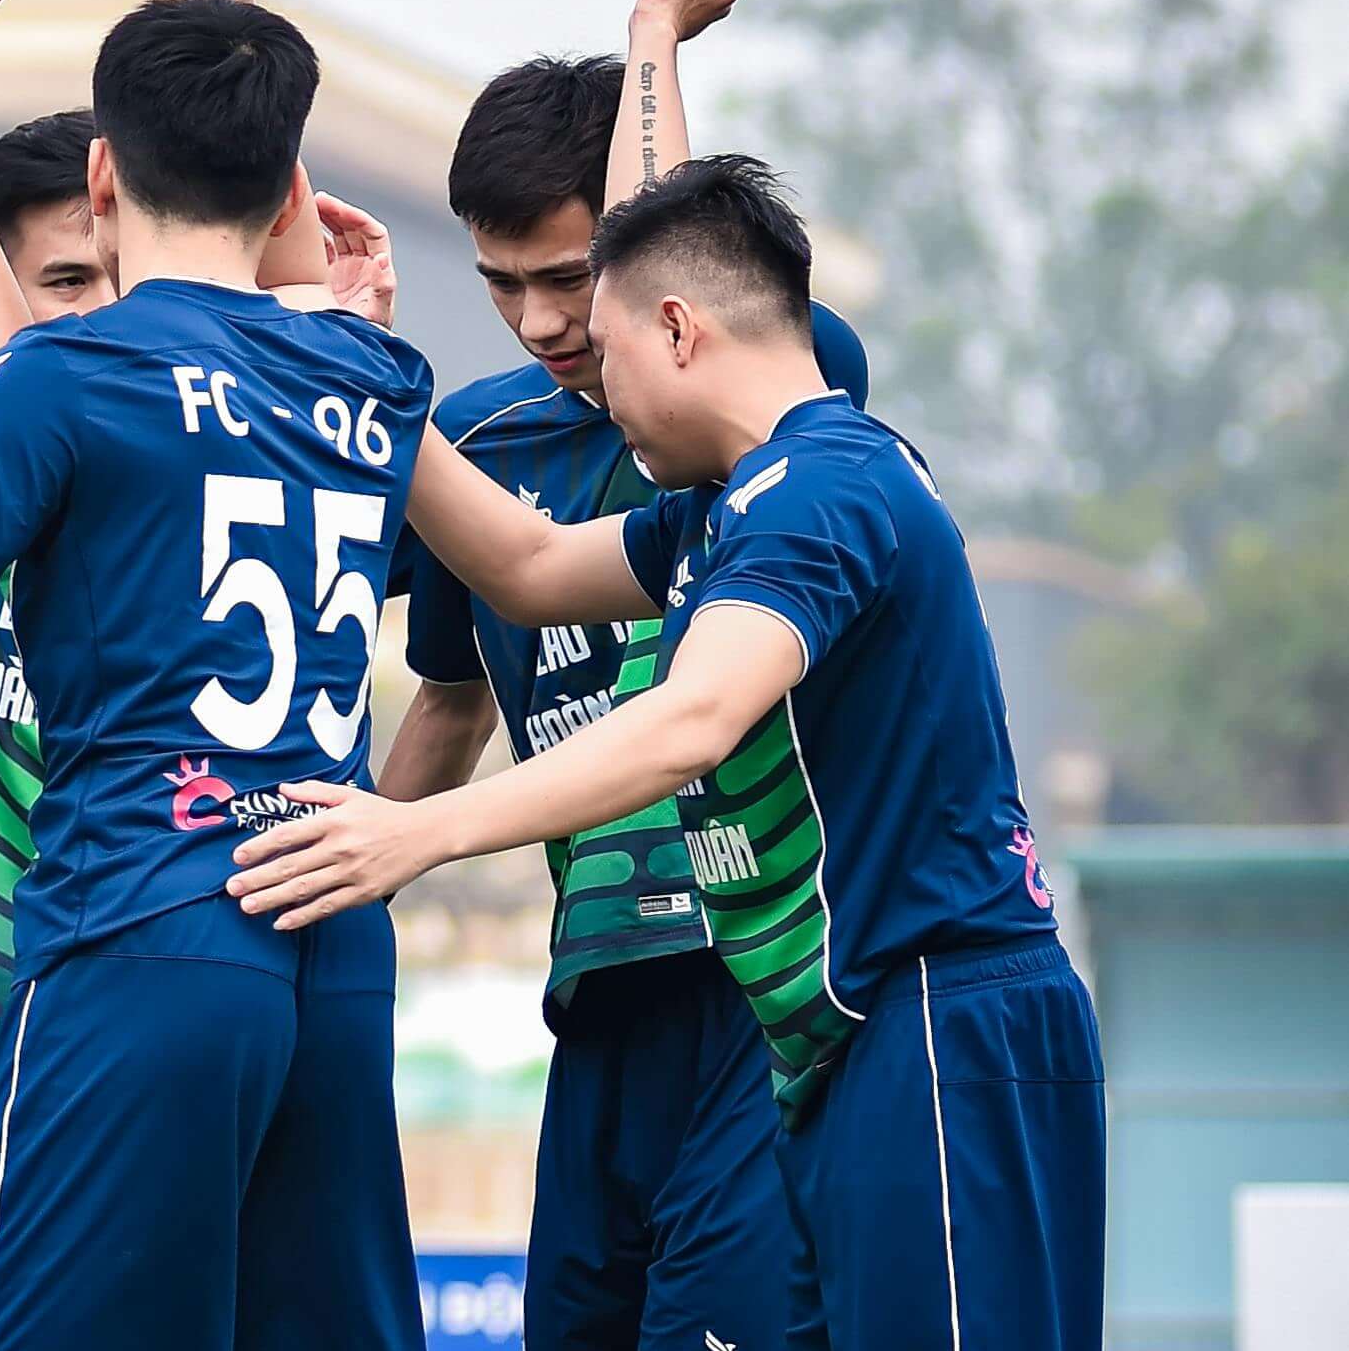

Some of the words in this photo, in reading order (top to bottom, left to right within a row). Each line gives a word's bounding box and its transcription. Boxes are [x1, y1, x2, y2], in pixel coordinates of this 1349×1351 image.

[172, 366, 250, 437] FC
[312, 396, 393, 466] 96
[190, 474, 386, 761] 55
[526, 689, 618, 755] HOÀN
